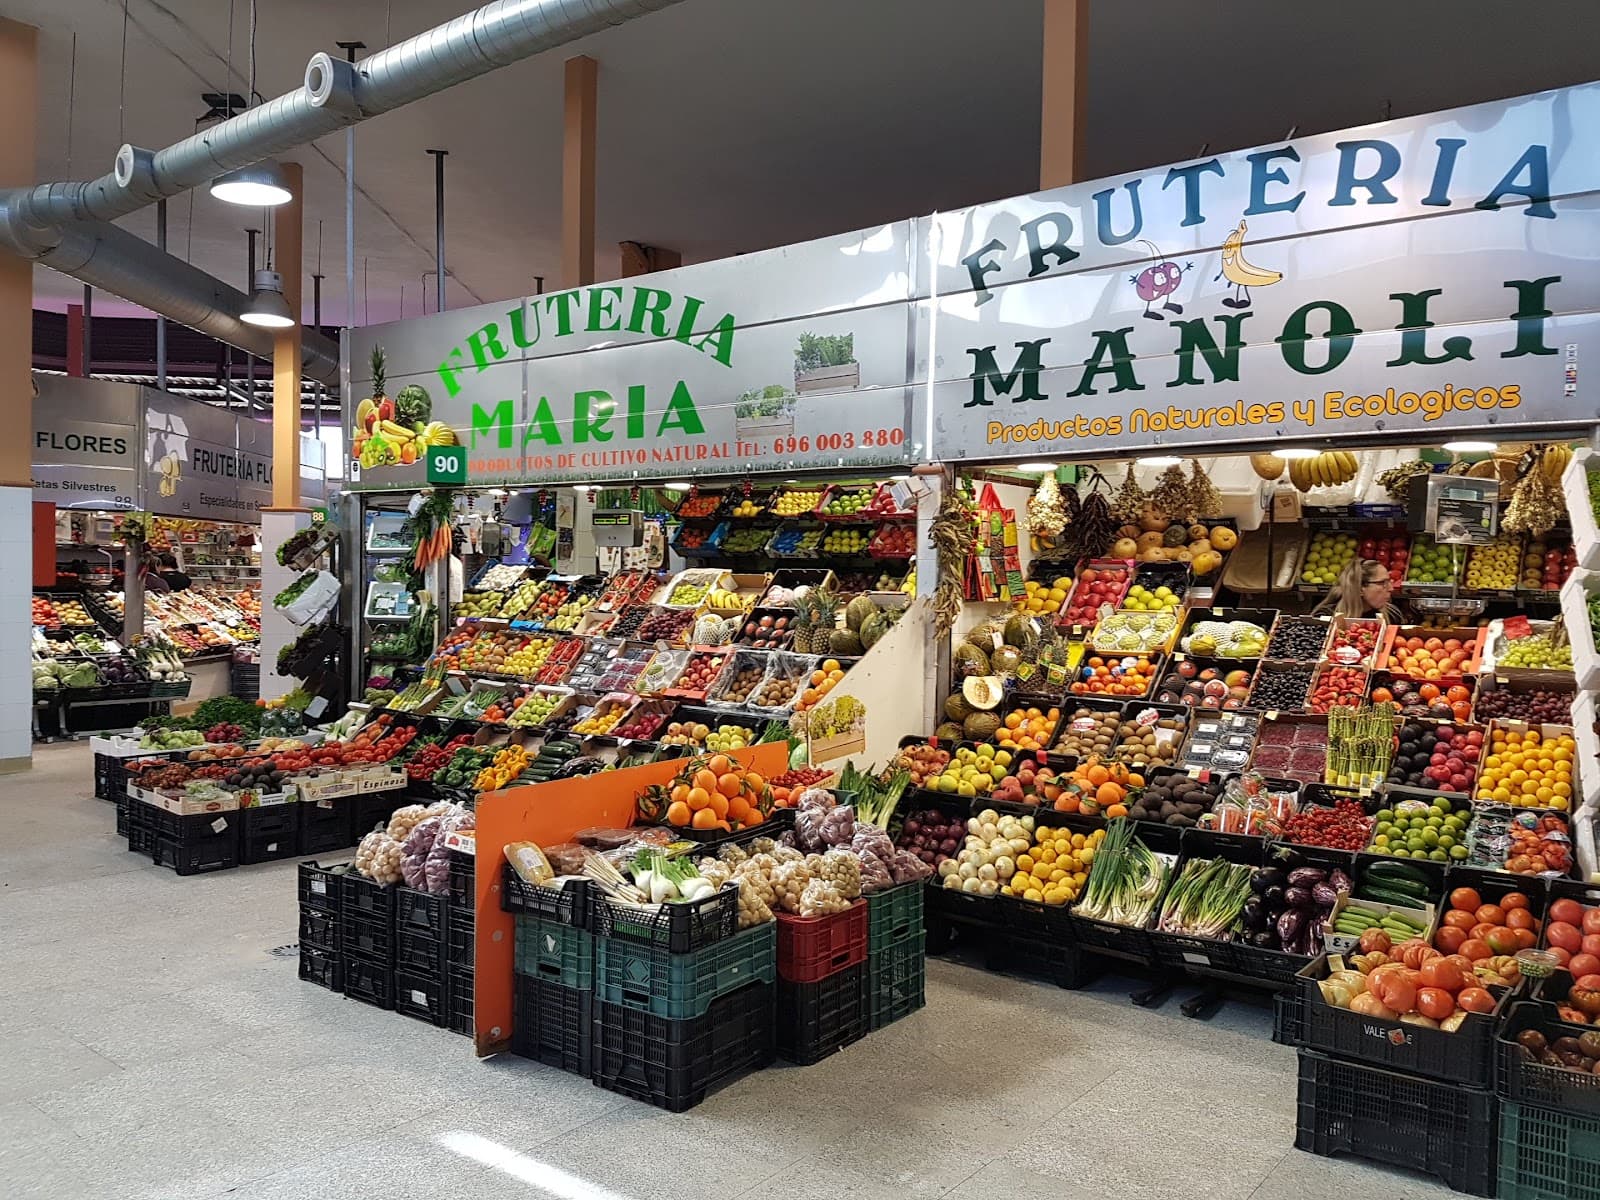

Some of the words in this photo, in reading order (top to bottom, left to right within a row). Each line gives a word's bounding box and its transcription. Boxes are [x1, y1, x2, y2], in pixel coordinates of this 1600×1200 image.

[961, 138, 1557, 308] FRUTERIA
[437, 286, 737, 398] FRUTERIA
[963, 275, 1562, 408] MANOLI
[470, 380, 706, 451] MARIA
[986, 413, 1123, 445] Productos
[1129, 399, 1285, 434] Naturales
[1292, 399, 1316, 427] y
[1323, 383, 1522, 423] Ecologicos
[36, 431, 127, 455] FLORES
[468, 454, 551, 474] PRODUCTOS
[557, 453, 577, 469] DE
[581, 447, 647, 468] CULTIVO
[651, 441, 731, 463] NATURAL
[773, 435, 810, 455] 696
[815, 431, 855, 451] 003
[862, 427, 905, 447] 880
[193, 447, 254, 481] FRUTERÍA
[434, 455, 459, 474] 90
[31, 478, 59, 489] etas
[61, 480, 117, 492] Silvestres
[114, 495, 132, 509] 88
[312, 511, 325, 522] 88
[363, 778, 405, 789] Espinosa
[1363, 1023, 1386, 1040] VALE
